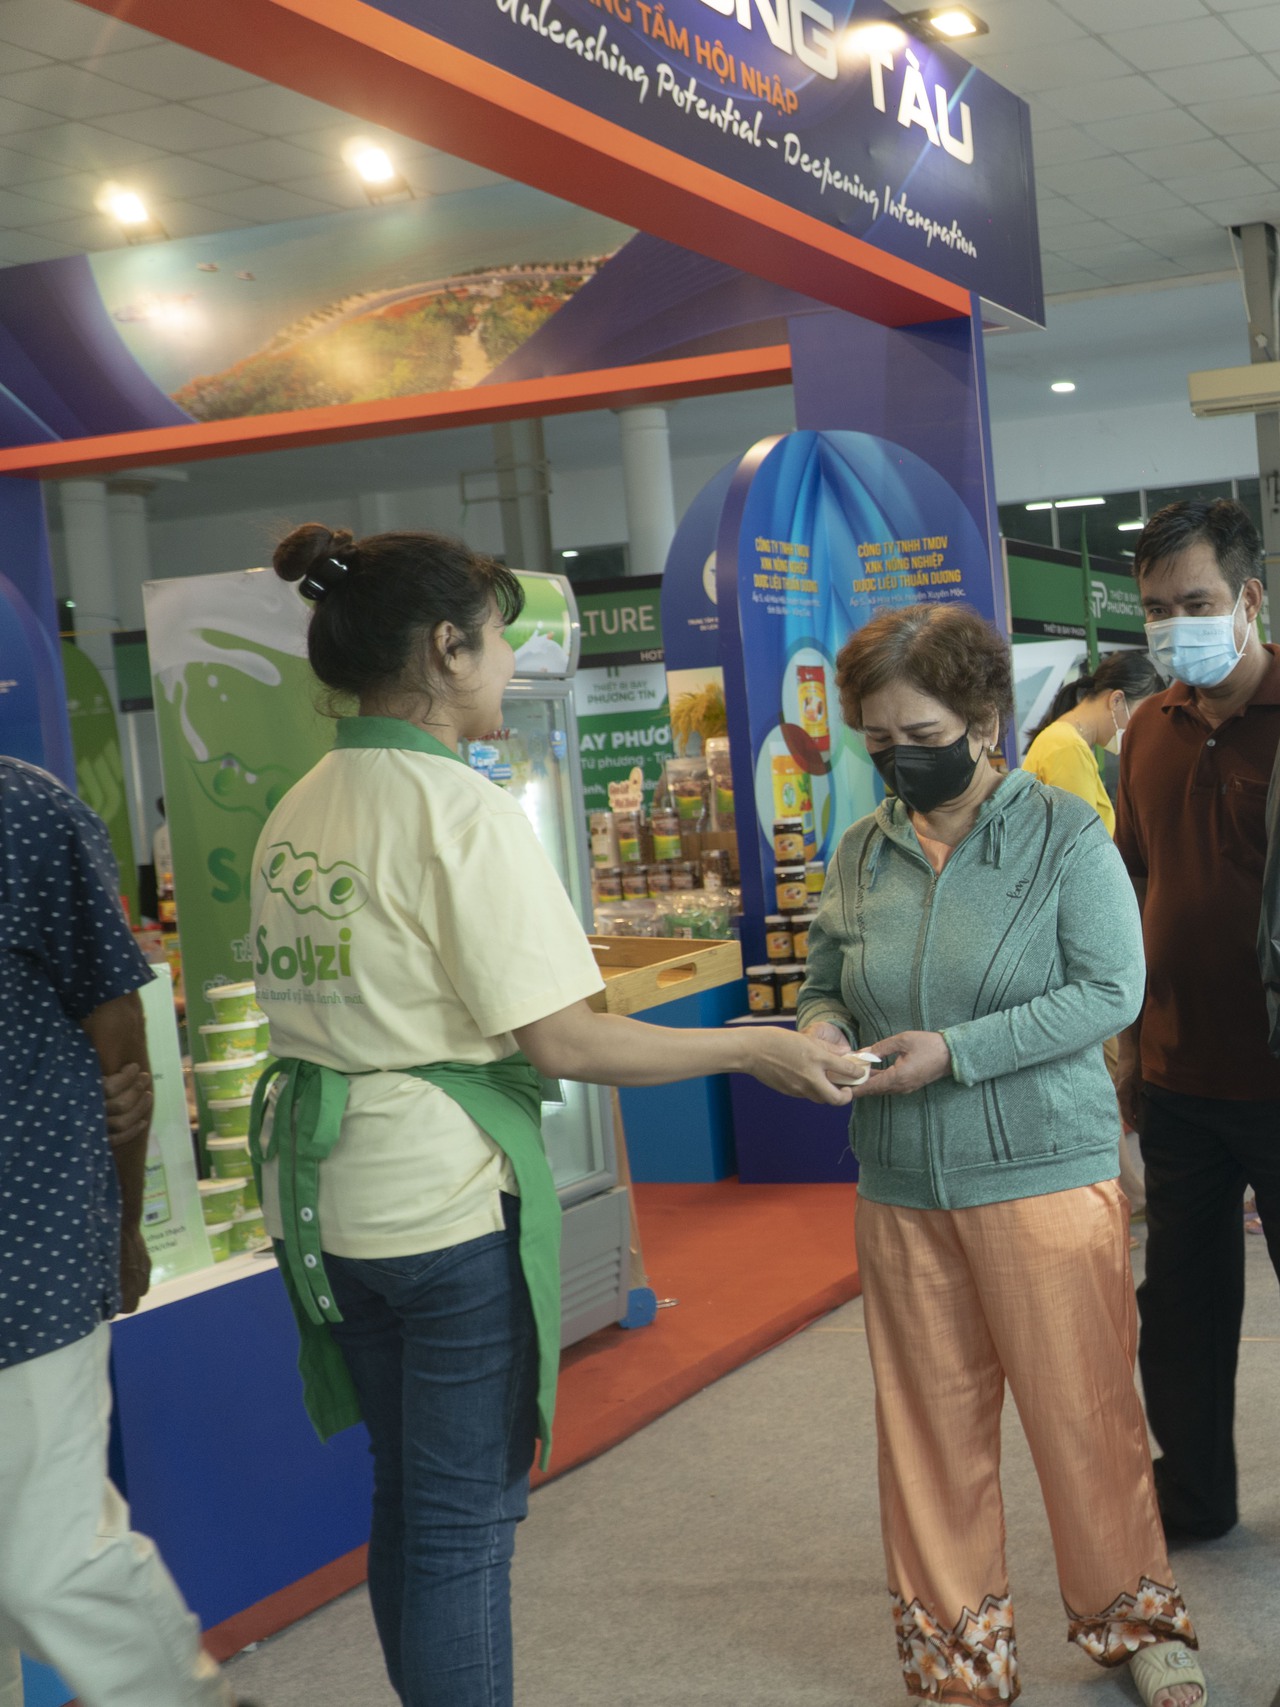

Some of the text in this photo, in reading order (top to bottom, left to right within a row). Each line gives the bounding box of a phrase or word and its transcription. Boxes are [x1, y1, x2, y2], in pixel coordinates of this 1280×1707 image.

[636, 1, 690, 58] TẦM
[695, 35, 735, 84] HỘI
[740, 61, 798, 116] NHẬP
[854, 46, 974, 165] TÀU
[656, 63, 763, 148] Potential
[784, 133, 880, 221] Deepening
[883, 186, 978, 259] Intergration
[857, 541, 882, 558] CÔNG
[884, 541, 896, 555] TY
[897, 539, 921, 553] TNHH
[885, 557, 910, 571] NÔNG
[911, 552, 944, 570] NGHIỆP
[580, 605, 655, 637] TURE
[580, 725, 670, 751] AY PHƯƠ
[256, 925, 352, 986] Soyzi
